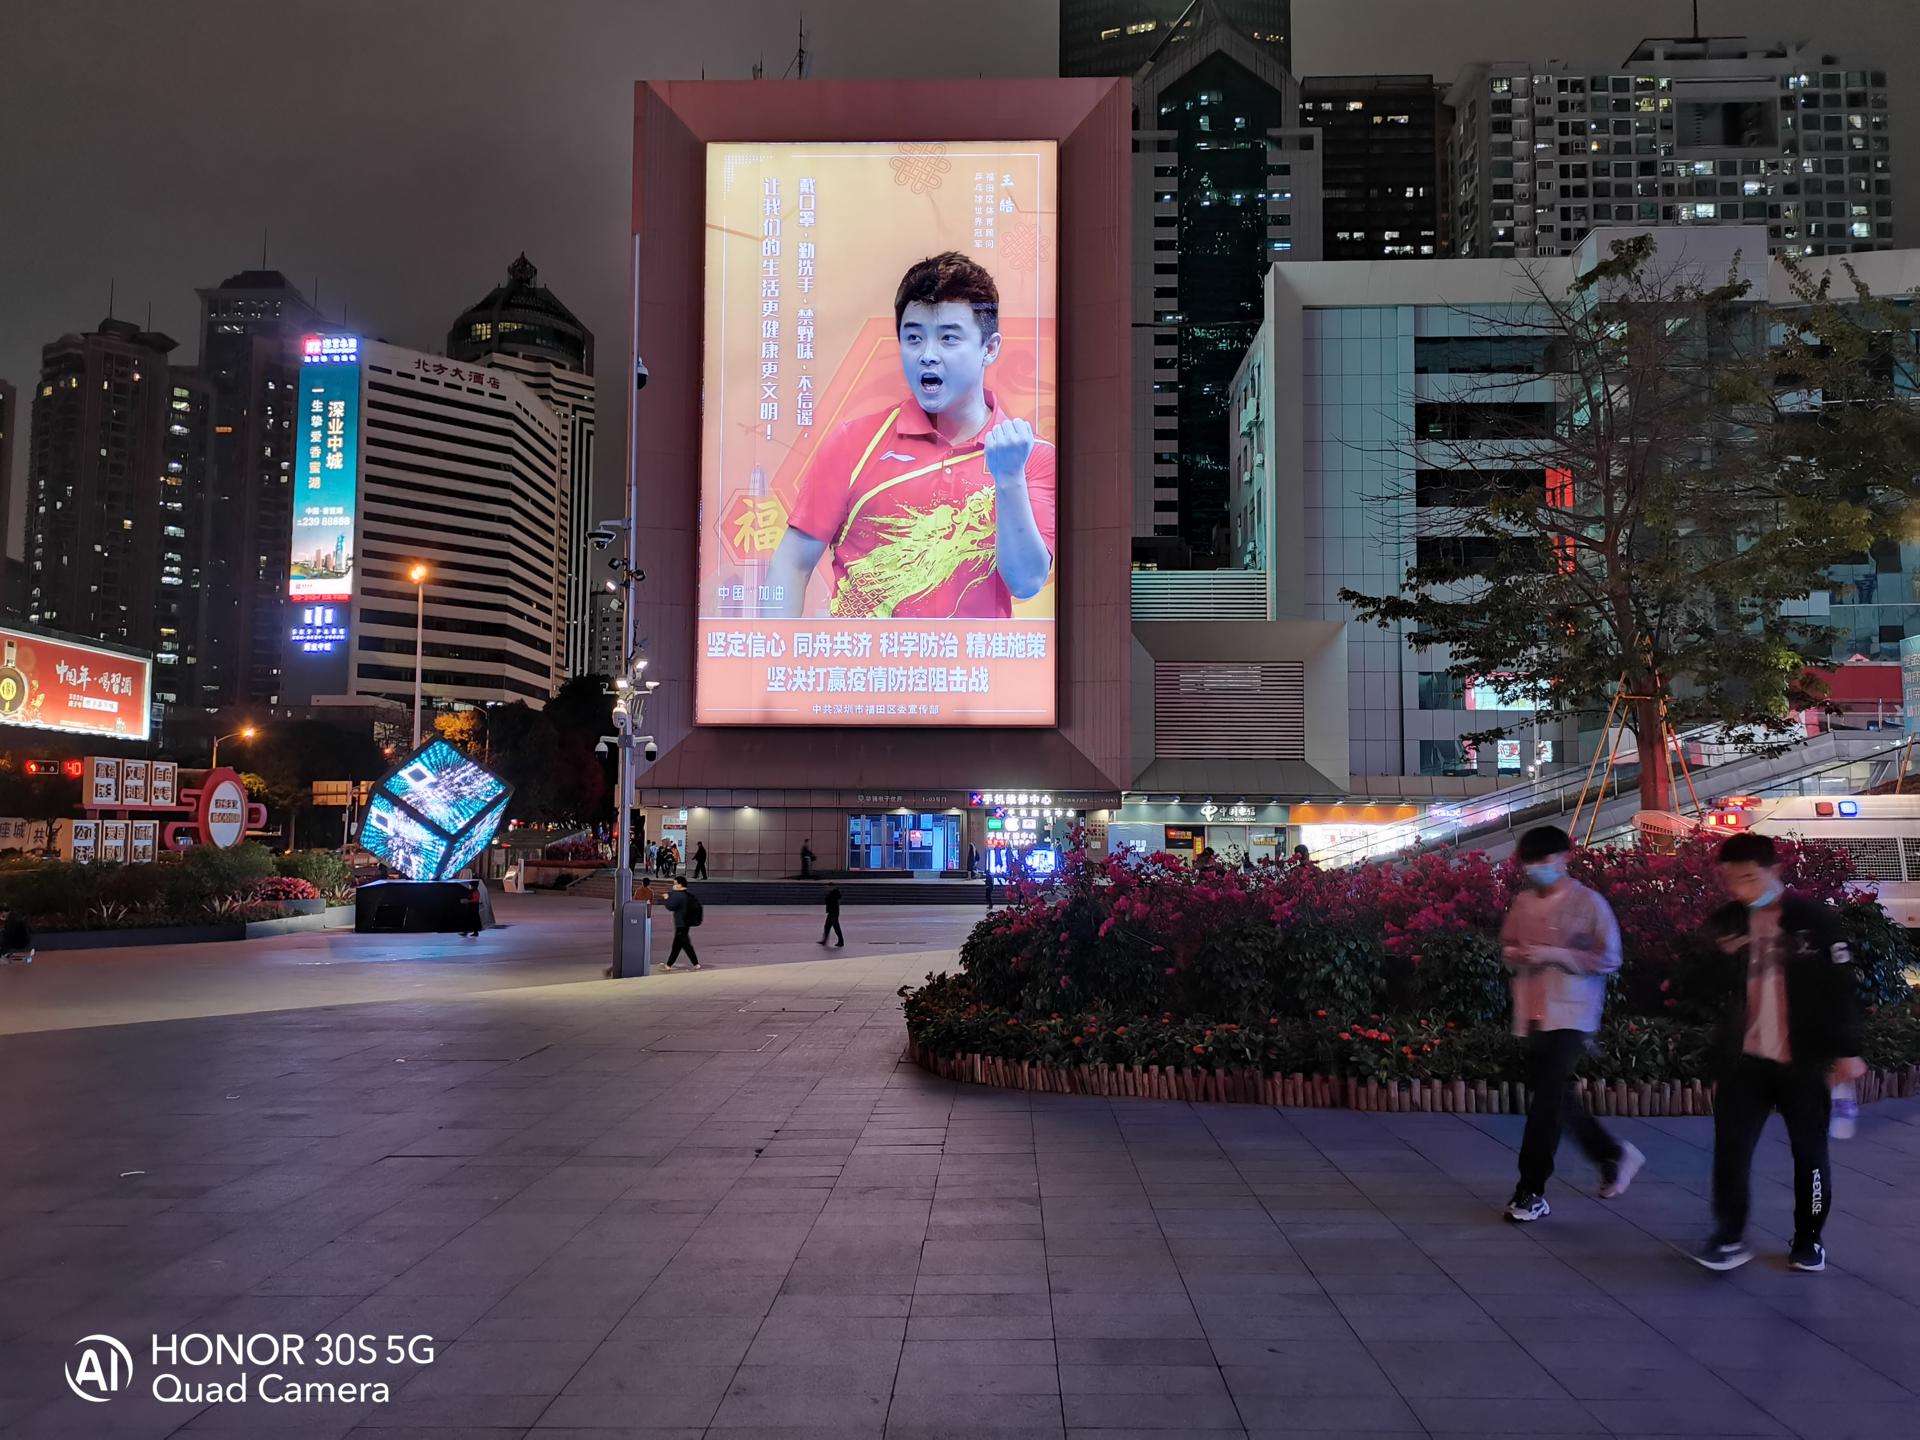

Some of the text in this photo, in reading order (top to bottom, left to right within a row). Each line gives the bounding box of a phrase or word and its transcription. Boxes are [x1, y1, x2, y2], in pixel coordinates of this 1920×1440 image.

[1000, 174, 1015, 213] 王皓
[414, 358, 501, 389] 北方大酒店
[325, 401, 345, 470] 深业中城
[733, 499, 783, 552] 福
[707, 632, 1046, 658] 坚定信心 同舟共济 科学防治 精准施策
[767, 667, 989, 693] 坚决打赢疫情防控阻击战
[812, 704, 940, 715] 中共深圳市福田区委宣传部
[126, 766, 146, 780] 文明
[155, 767, 173, 782] 自由
[125, 785, 146, 799] 和谐
[982, 794, 1052, 805] 手机维修中心
[1219, 806, 1256, 817] 中国电信
[105, 825, 126, 840] 爱国
[134, 826, 154, 840] 诚信
[74, 845, 95, 861] 法治
